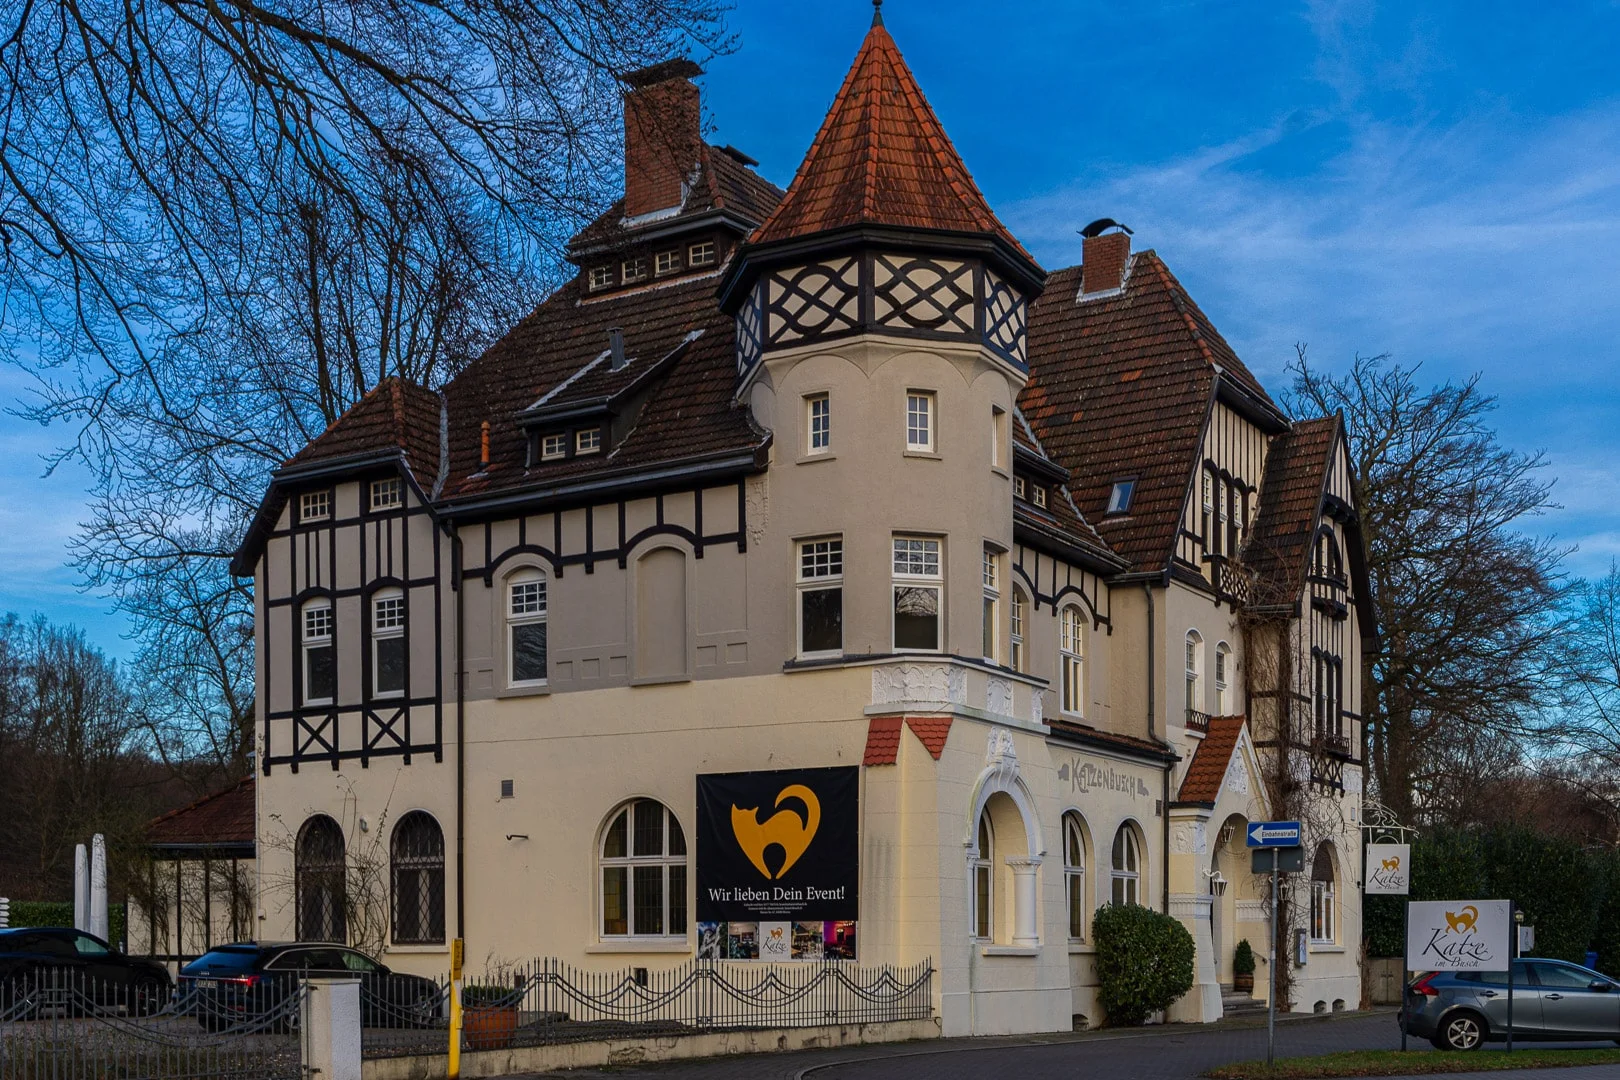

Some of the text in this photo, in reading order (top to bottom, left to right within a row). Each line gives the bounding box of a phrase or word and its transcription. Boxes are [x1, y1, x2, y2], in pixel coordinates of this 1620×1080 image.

[1369, 868, 1408, 887] Katze
[708, 886, 845, 901] Wir lieben Dein Event!
[1422, 928, 1493, 962] Katze
[1434, 957, 1480, 968] im Busch
